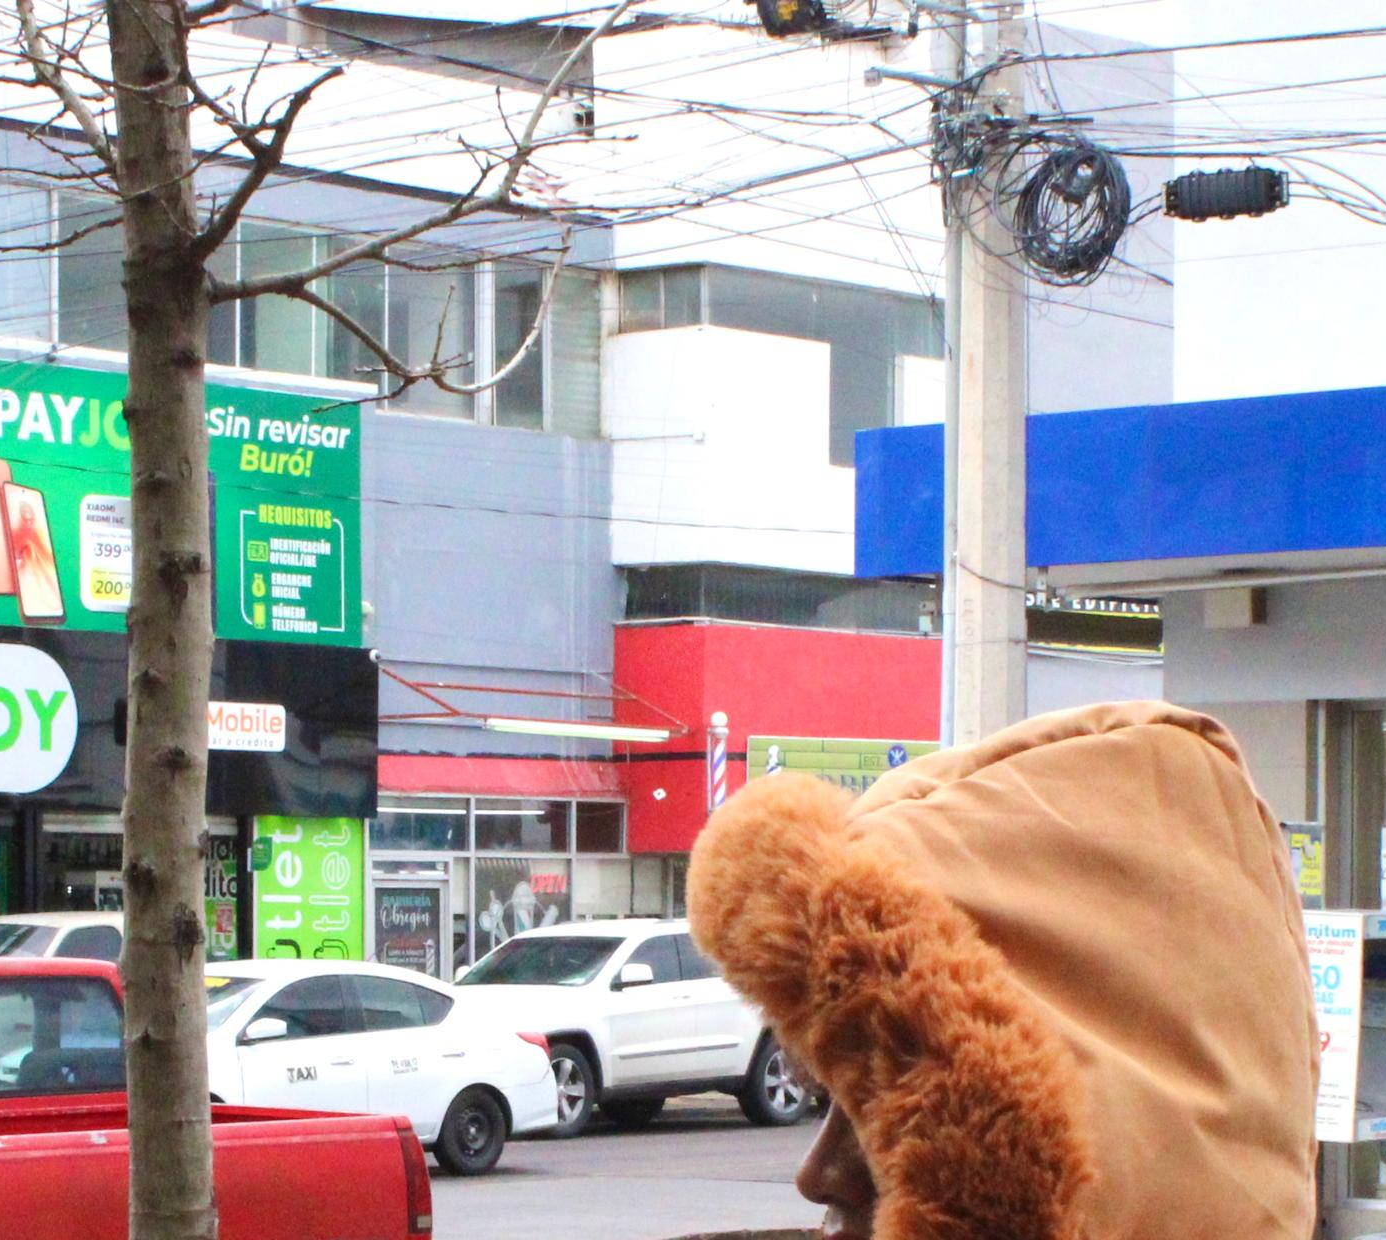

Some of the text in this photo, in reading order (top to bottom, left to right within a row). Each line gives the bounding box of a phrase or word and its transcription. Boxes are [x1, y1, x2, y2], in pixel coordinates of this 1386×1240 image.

[258, 415, 350, 448] revisar
[240, 444, 313, 477] Buró!
[86, 503, 115, 512] XIAOMI
[259, 504, 332, 529] REQUISITOS
[271, 585, 301, 599] INICIAL
[272, 603, 306, 619] NÚMERO
[530, 873, 567, 894] OPEN
[1308, 924, 1356, 939] nitum
[1311, 965, 1341, 990] 50
[287, 1066, 318, 1083] TAXI
